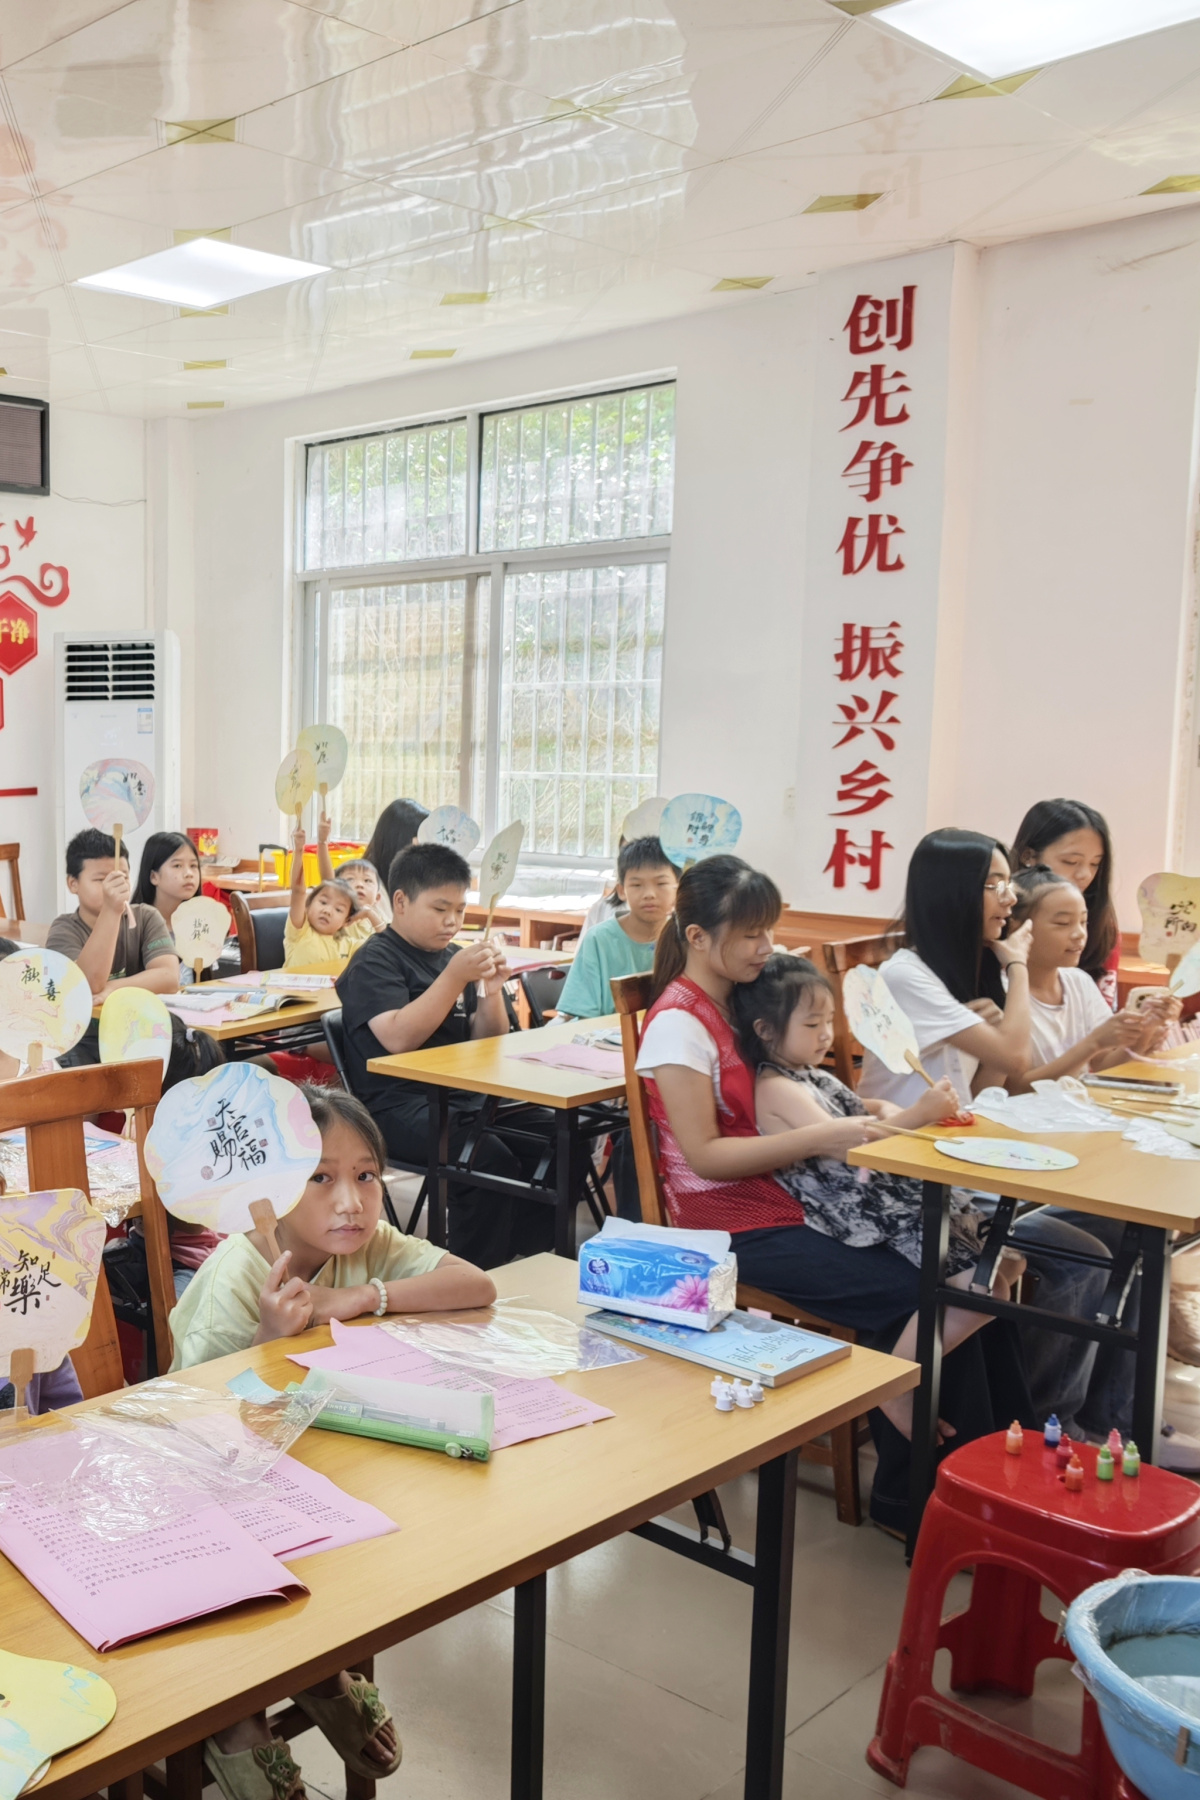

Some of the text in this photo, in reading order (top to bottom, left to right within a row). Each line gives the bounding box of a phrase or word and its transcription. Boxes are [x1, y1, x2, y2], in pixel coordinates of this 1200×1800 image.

[822, 284, 919, 892] 创先争优 振兴乡村
